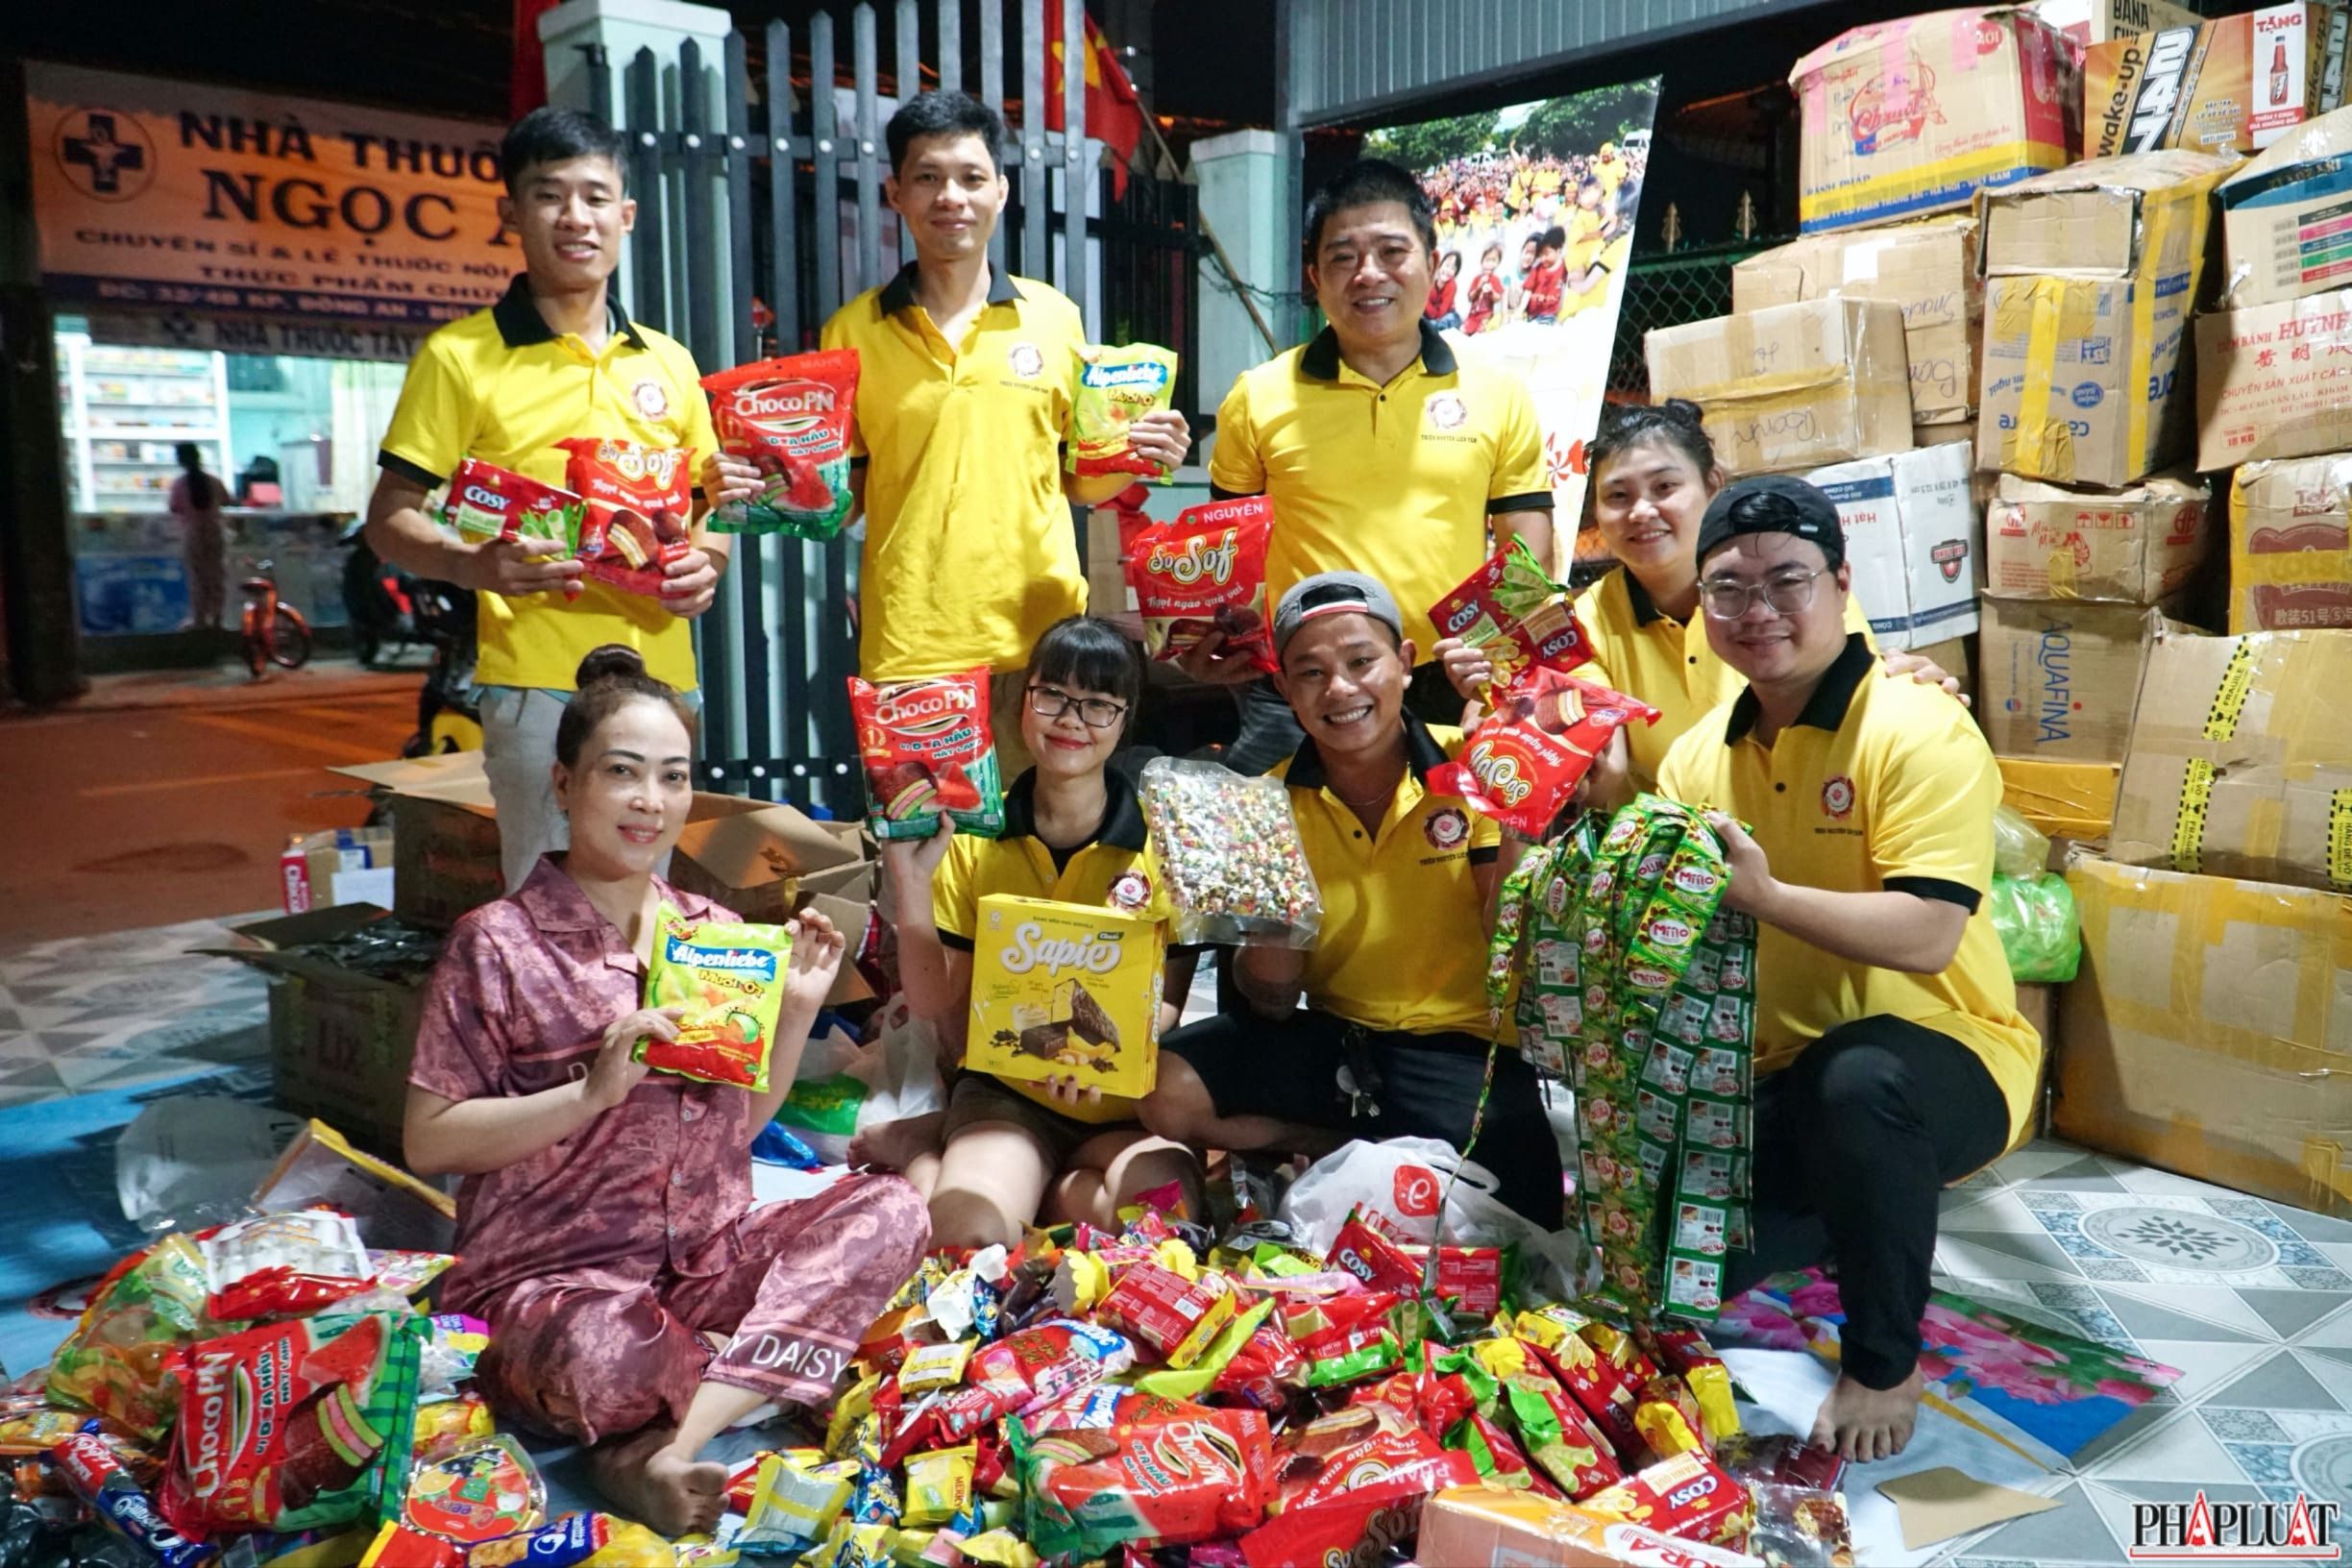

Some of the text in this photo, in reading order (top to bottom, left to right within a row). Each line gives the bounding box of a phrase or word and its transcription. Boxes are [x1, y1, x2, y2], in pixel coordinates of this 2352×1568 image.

[179, 110, 316, 161] NHÀ
[201, 167, 458, 247] NGỌC
[463, 484, 510, 511] COSY
[1446, 598, 1482, 633] COSY
[1540, 629, 1580, 661] COSY
[2036, 615, 2073, 744] AQUAFINA
[1678, 871, 1715, 887] Miilo
[1653, 923, 1689, 938] Miilo
[672, 943, 770, 970] Alpenliebe
[1000, 922, 1123, 977] Sapie
[1338, 1248, 1377, 1283] COSY
[750, 1333, 852, 1384] DAISY
[1668, 1475, 1718, 1510] COSY
